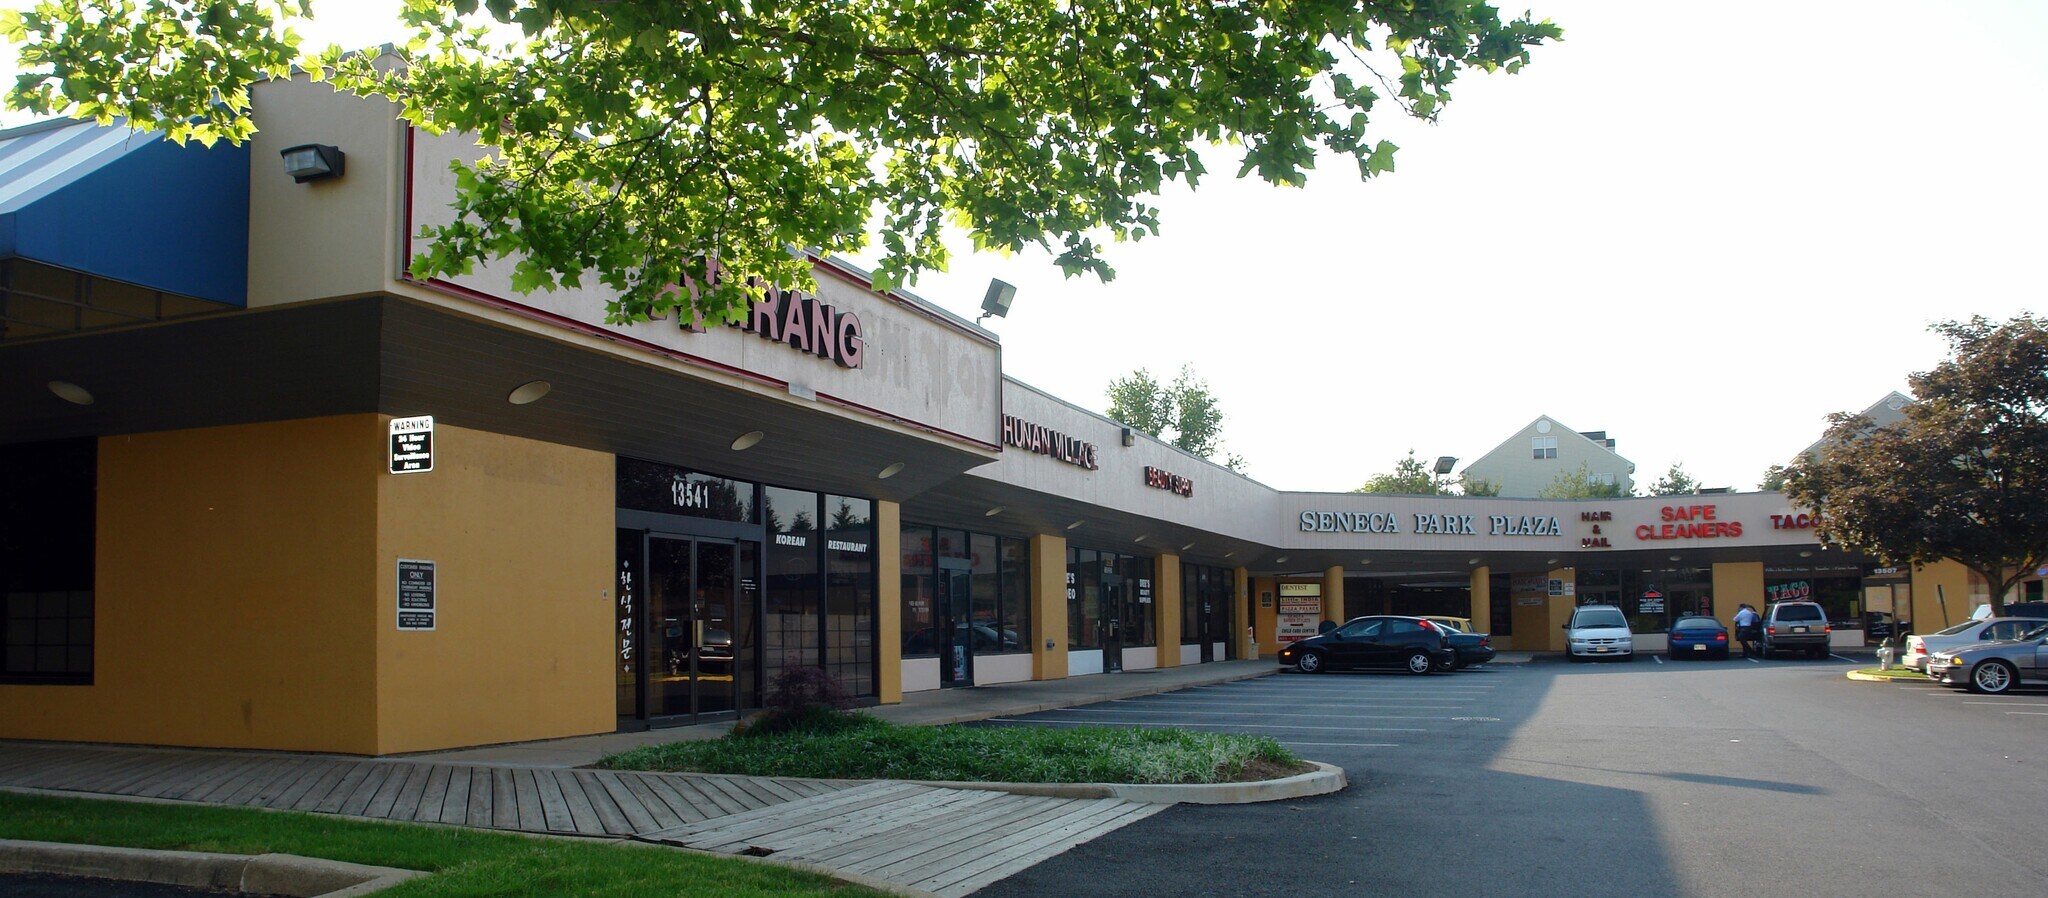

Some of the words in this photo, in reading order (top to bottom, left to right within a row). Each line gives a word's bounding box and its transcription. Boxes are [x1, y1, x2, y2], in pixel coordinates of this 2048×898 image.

[394, 420, 430, 431] WARNING
[1003, 414, 1050, 455] HUNAN
[402, 443, 421, 451] Video
[404, 461, 420, 470] Area
[671, 481, 709, 509] 13541
[1582, 511, 1612, 521] HAIR
[1661, 505, 1716, 521] SAFE
[1300, 511, 1400, 533] SENECA
[1413, 513, 1477, 534] PARK
[1490, 515, 1563, 536] PLAZA
[1592, 524, 1600, 534] &
[1770, 514, 1823, 530] TACO
[1636, 521, 1743, 541] CLEANERS
[775, 534, 806, 547] KOREAN
[828, 540, 867, 553] RESTAURANT
[1582, 537, 1611, 548] NAIL
[409, 571, 424, 579] ONLY
[1767, 580, 1810, 601] TACO
[621, 571, 632, 660] 한식전문
